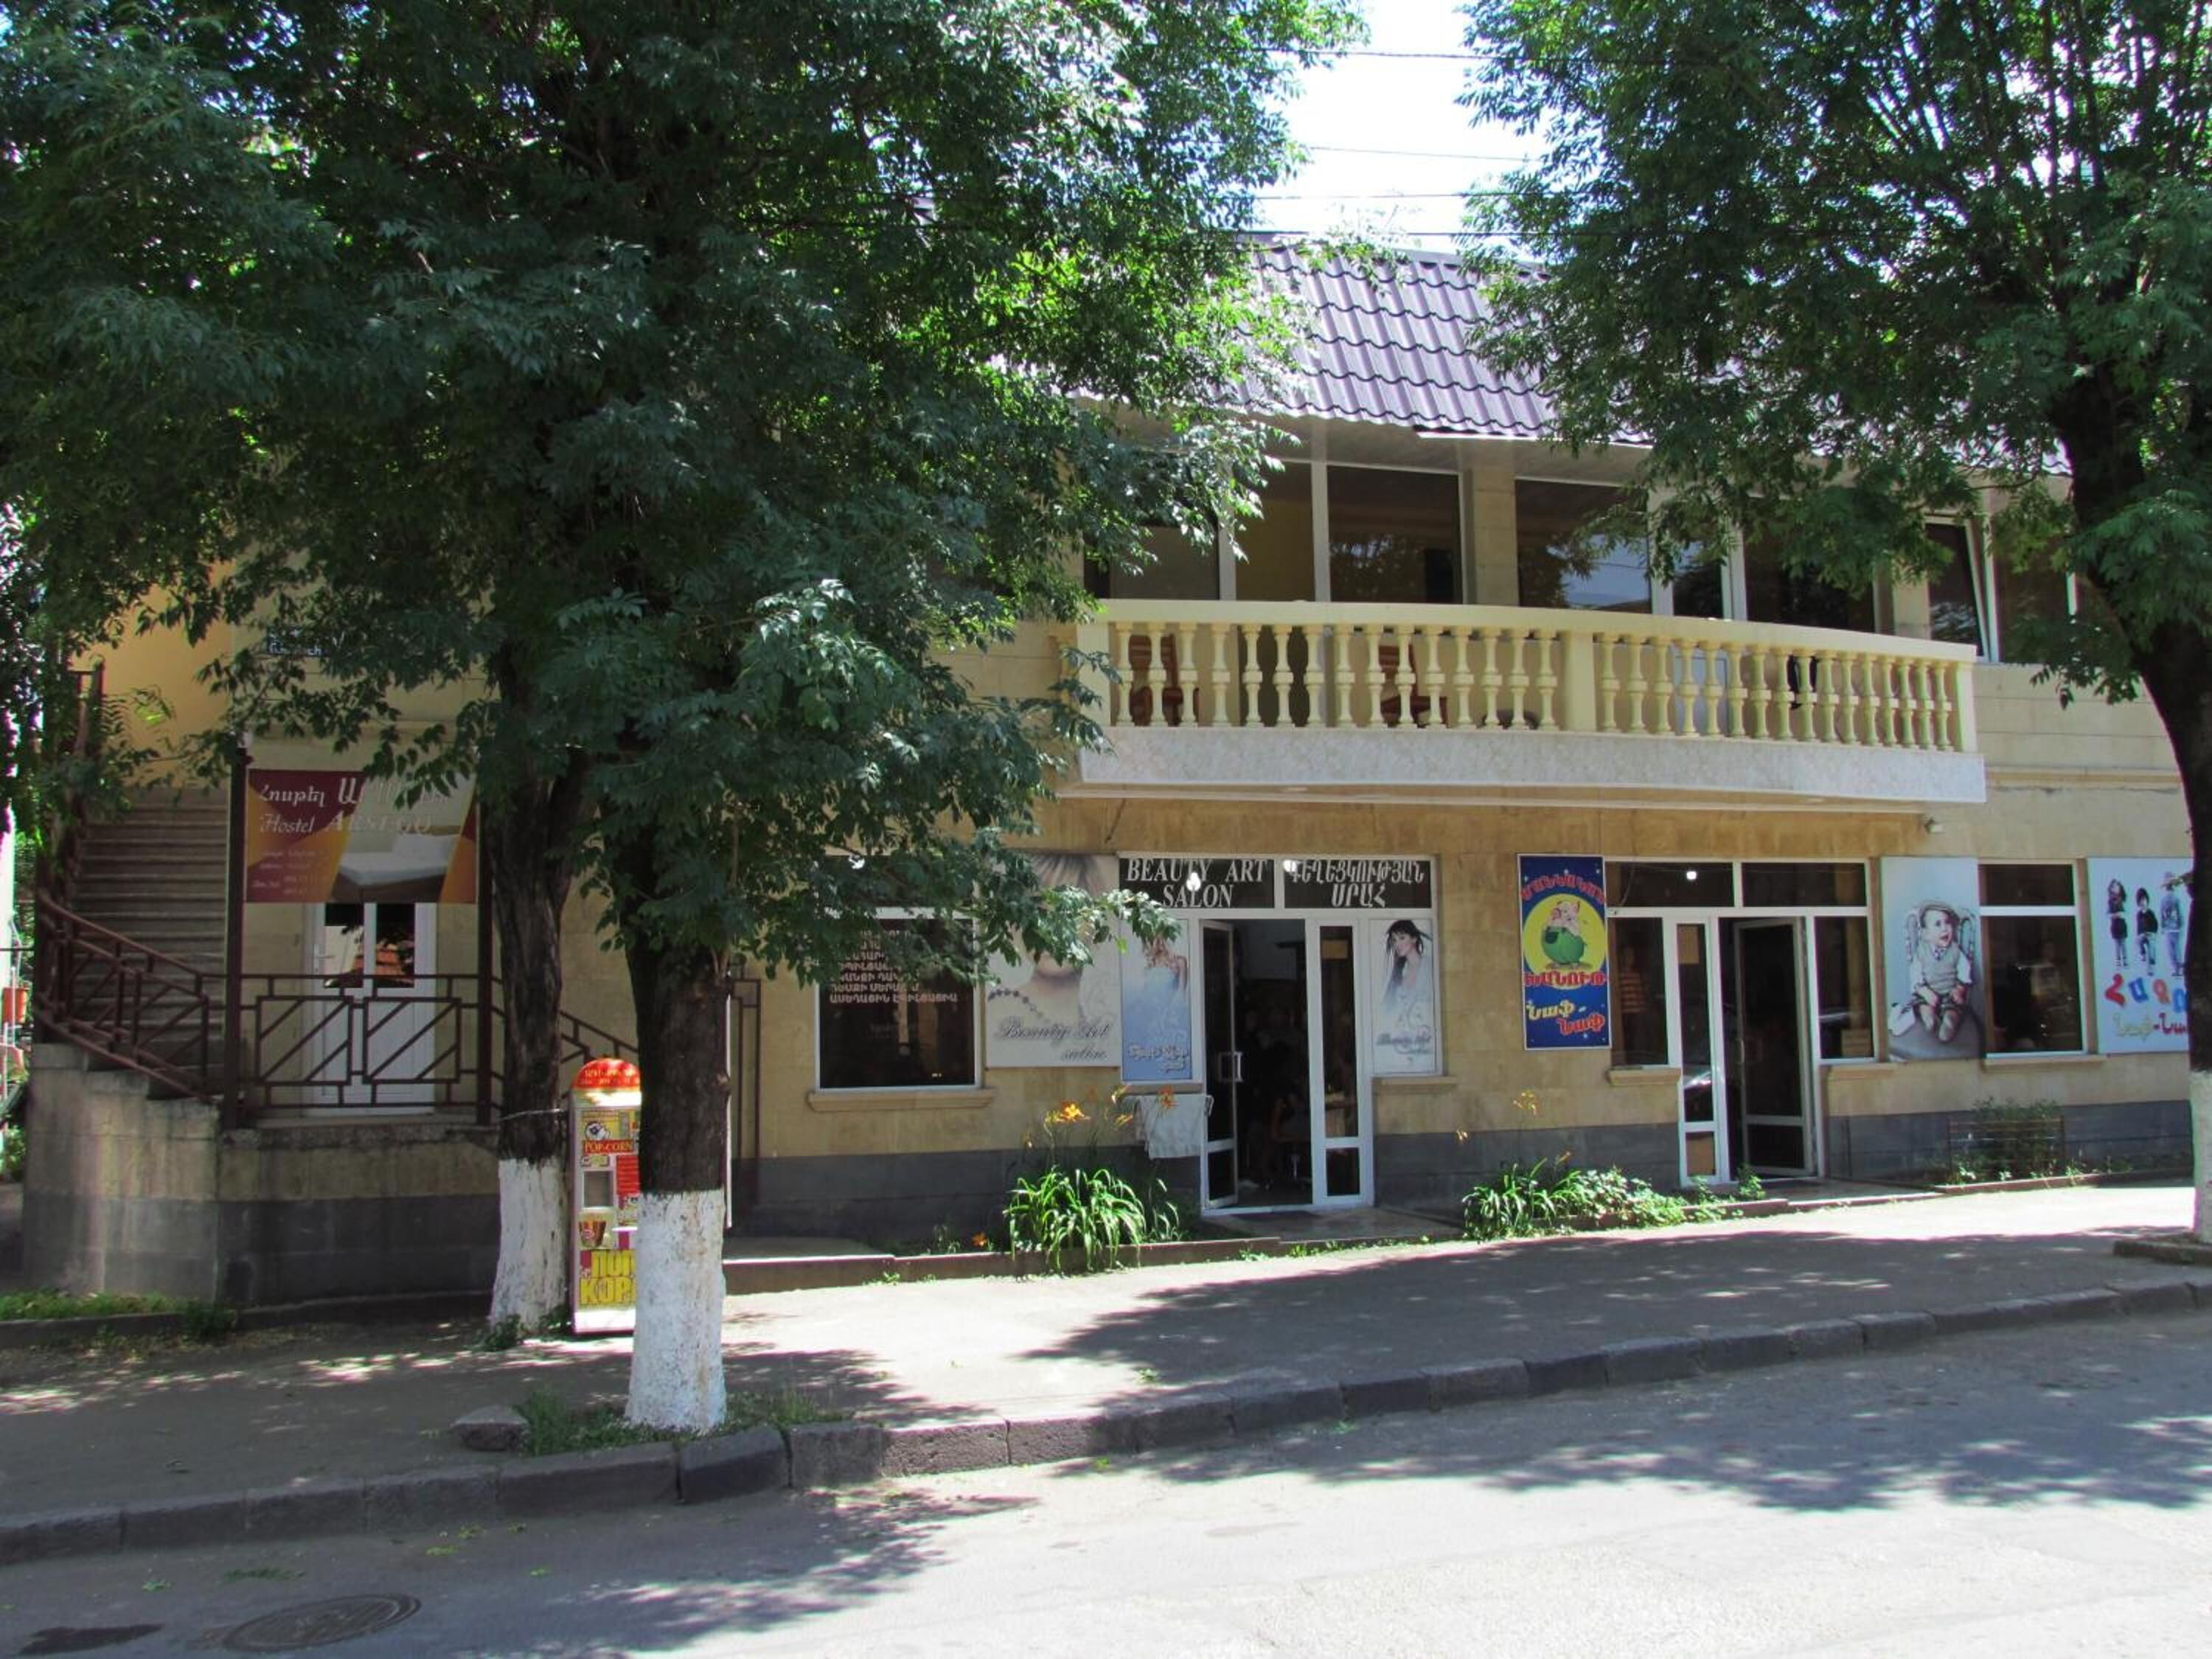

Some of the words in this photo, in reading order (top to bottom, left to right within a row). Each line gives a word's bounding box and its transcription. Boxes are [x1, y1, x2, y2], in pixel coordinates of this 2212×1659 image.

[260, 813, 315, 834] Hostel
[1127, 858, 1212, 882] BEAUTY
[1225, 859, 1268, 883] ART
[1162, 884, 1234, 908] SALON
[1332, 883, 1385, 908] ՍՐԱՀ
